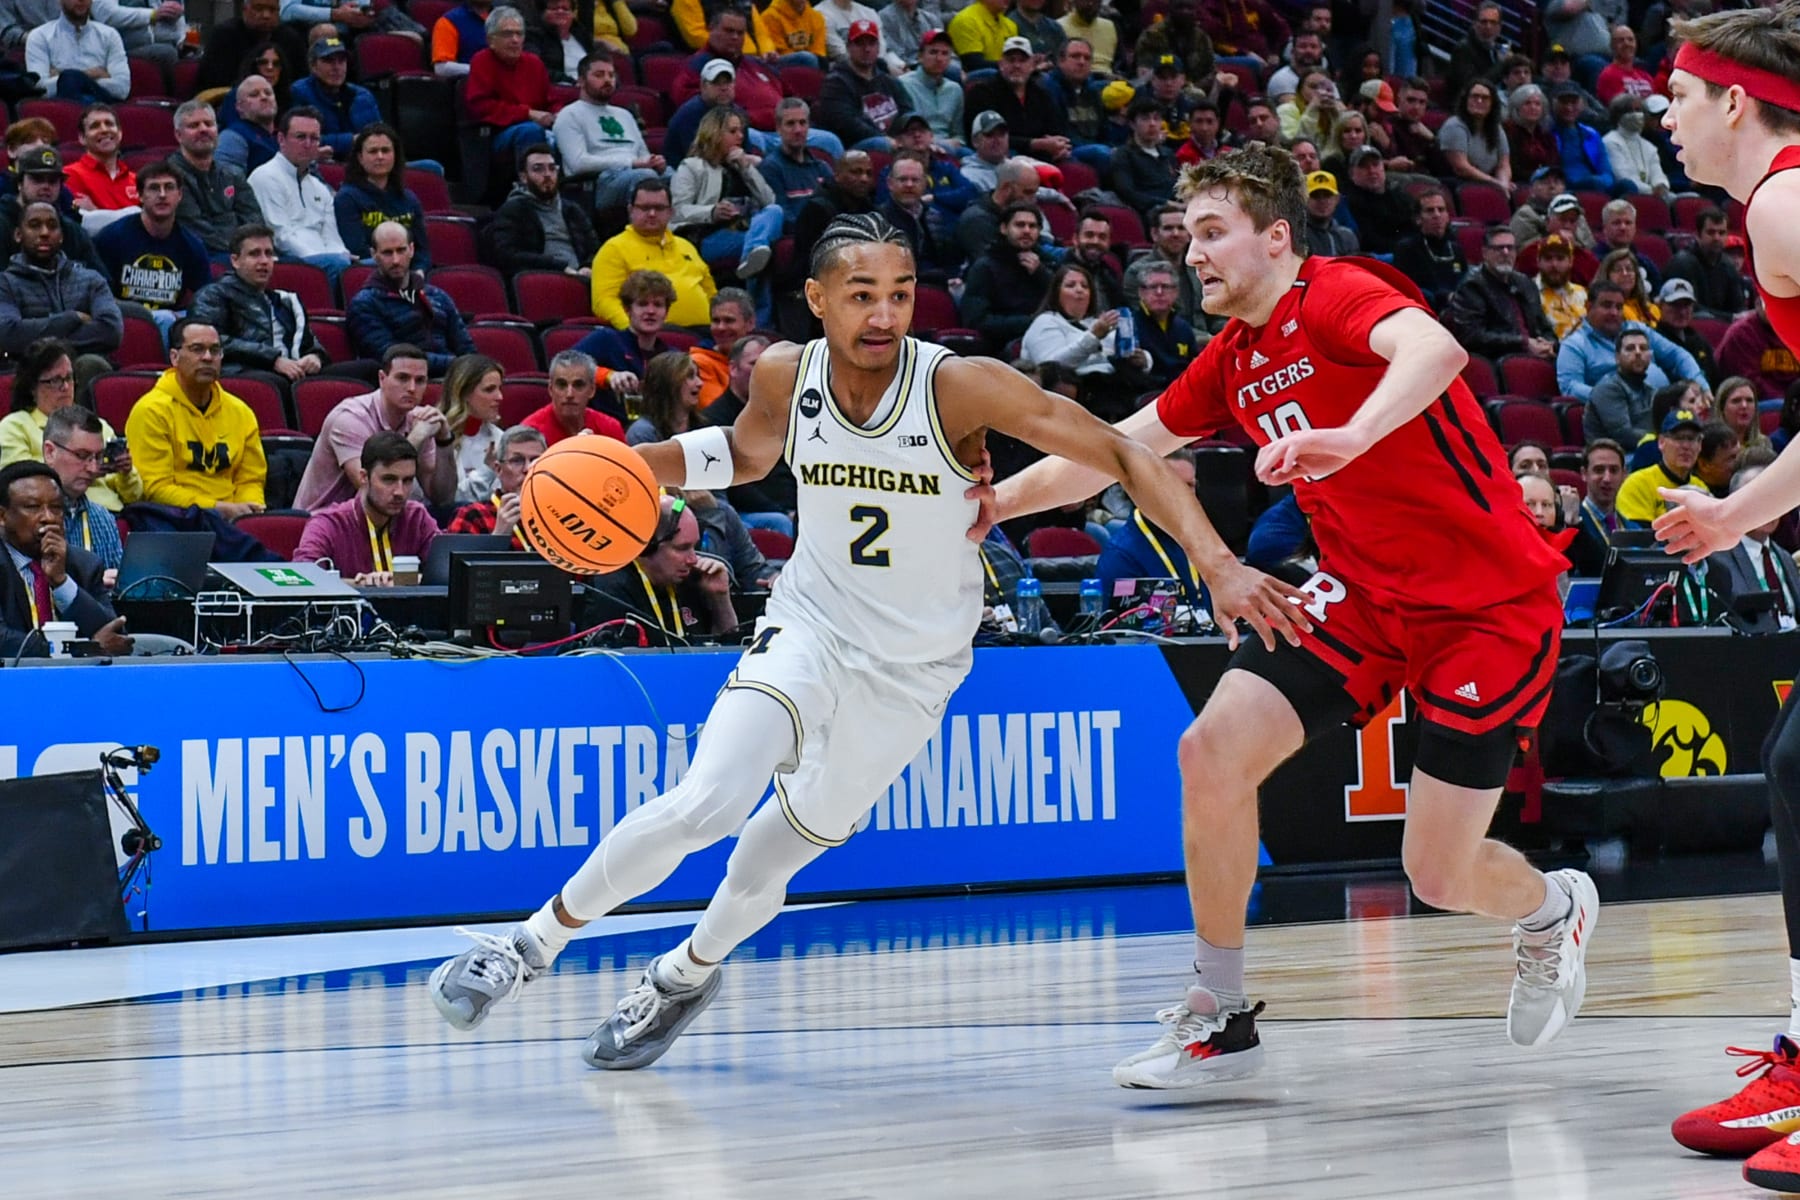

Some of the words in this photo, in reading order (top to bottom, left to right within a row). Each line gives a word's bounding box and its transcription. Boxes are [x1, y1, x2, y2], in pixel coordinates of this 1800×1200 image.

[186, 440, 232, 473] M
[800, 463, 941, 495] MICHIGAN
[559, 512, 613, 551] EVO
[849, 503, 891, 567] 2
[1288, 571, 1348, 623] R
[180, 733, 388, 866] MEN'S
[405, 723, 737, 854] BASKETBA
